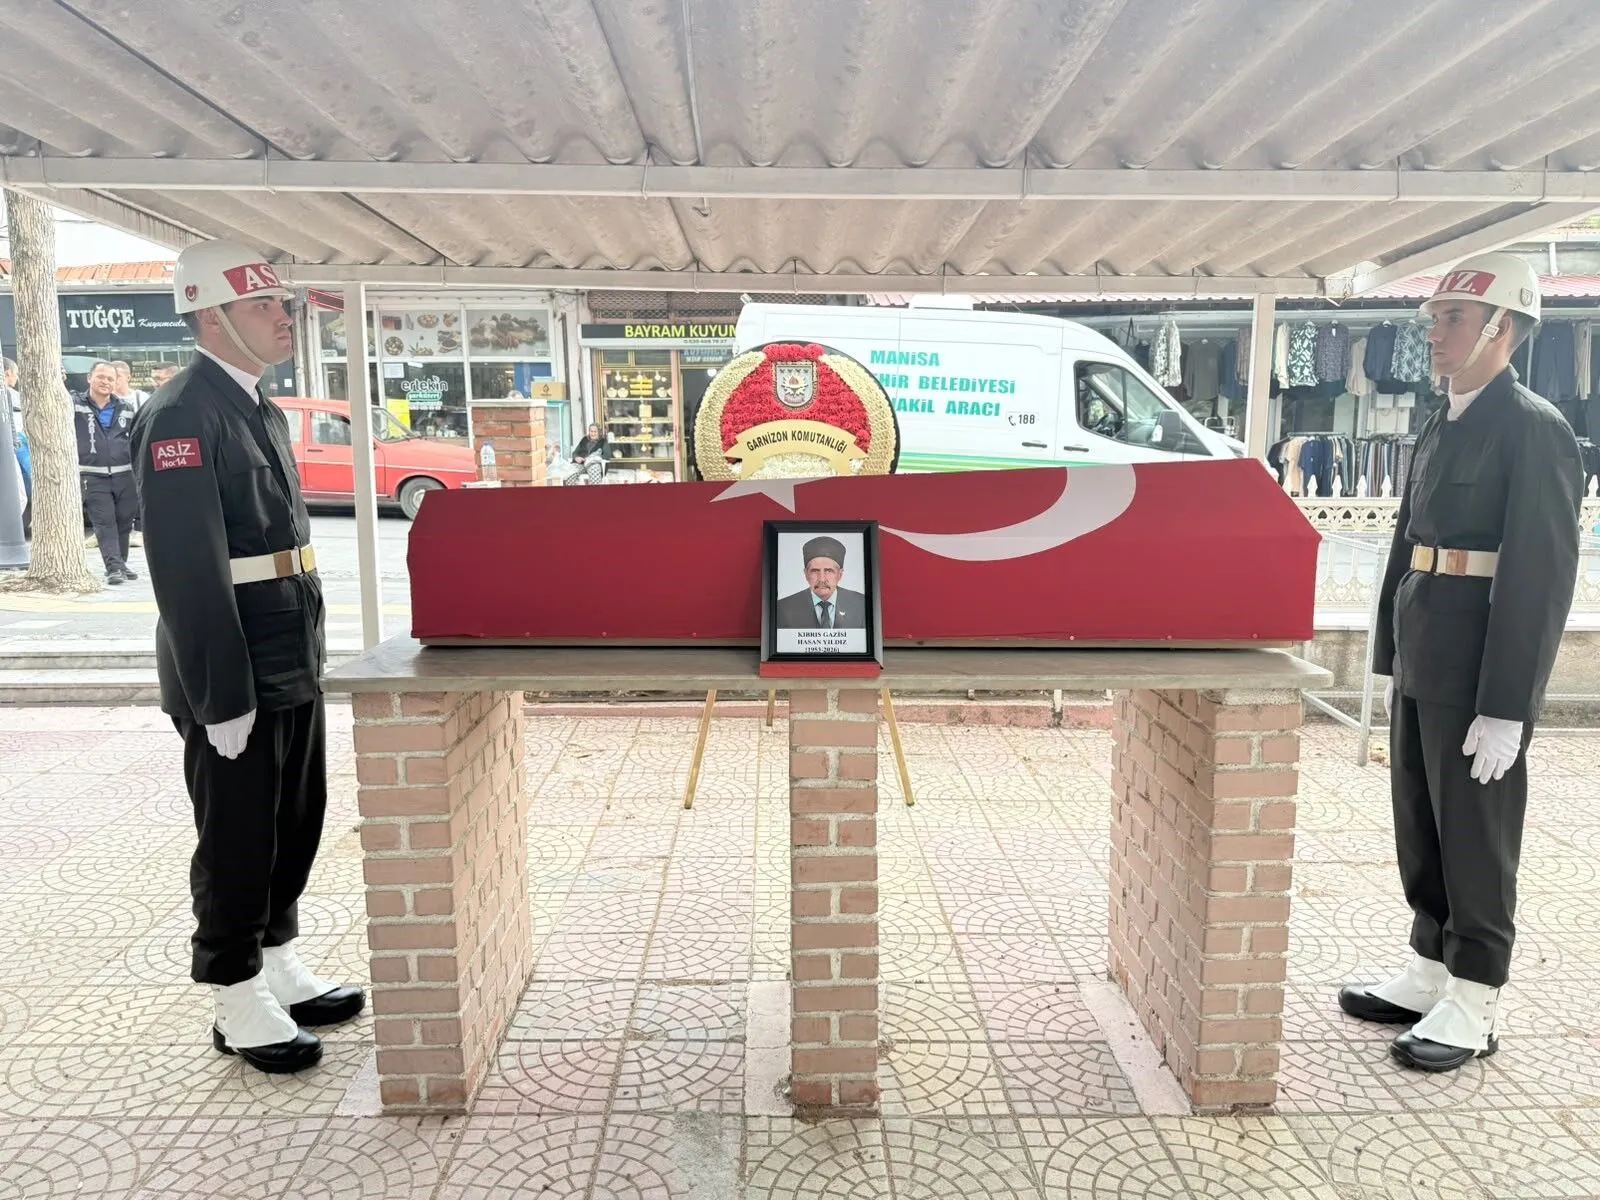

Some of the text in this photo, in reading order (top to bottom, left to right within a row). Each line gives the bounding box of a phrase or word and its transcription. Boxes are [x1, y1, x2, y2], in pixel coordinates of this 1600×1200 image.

[66, 305, 135, 334] TUĞÇE
[624, 325, 686, 338] BAYRAM
[945, 400, 1001, 417] ARACI
[1018, 414, 1036, 425] 188
[87, 413, 98, 454] ZABITA
[746, 430, 848, 454] GARNİZON KOMUTANLIĞI
